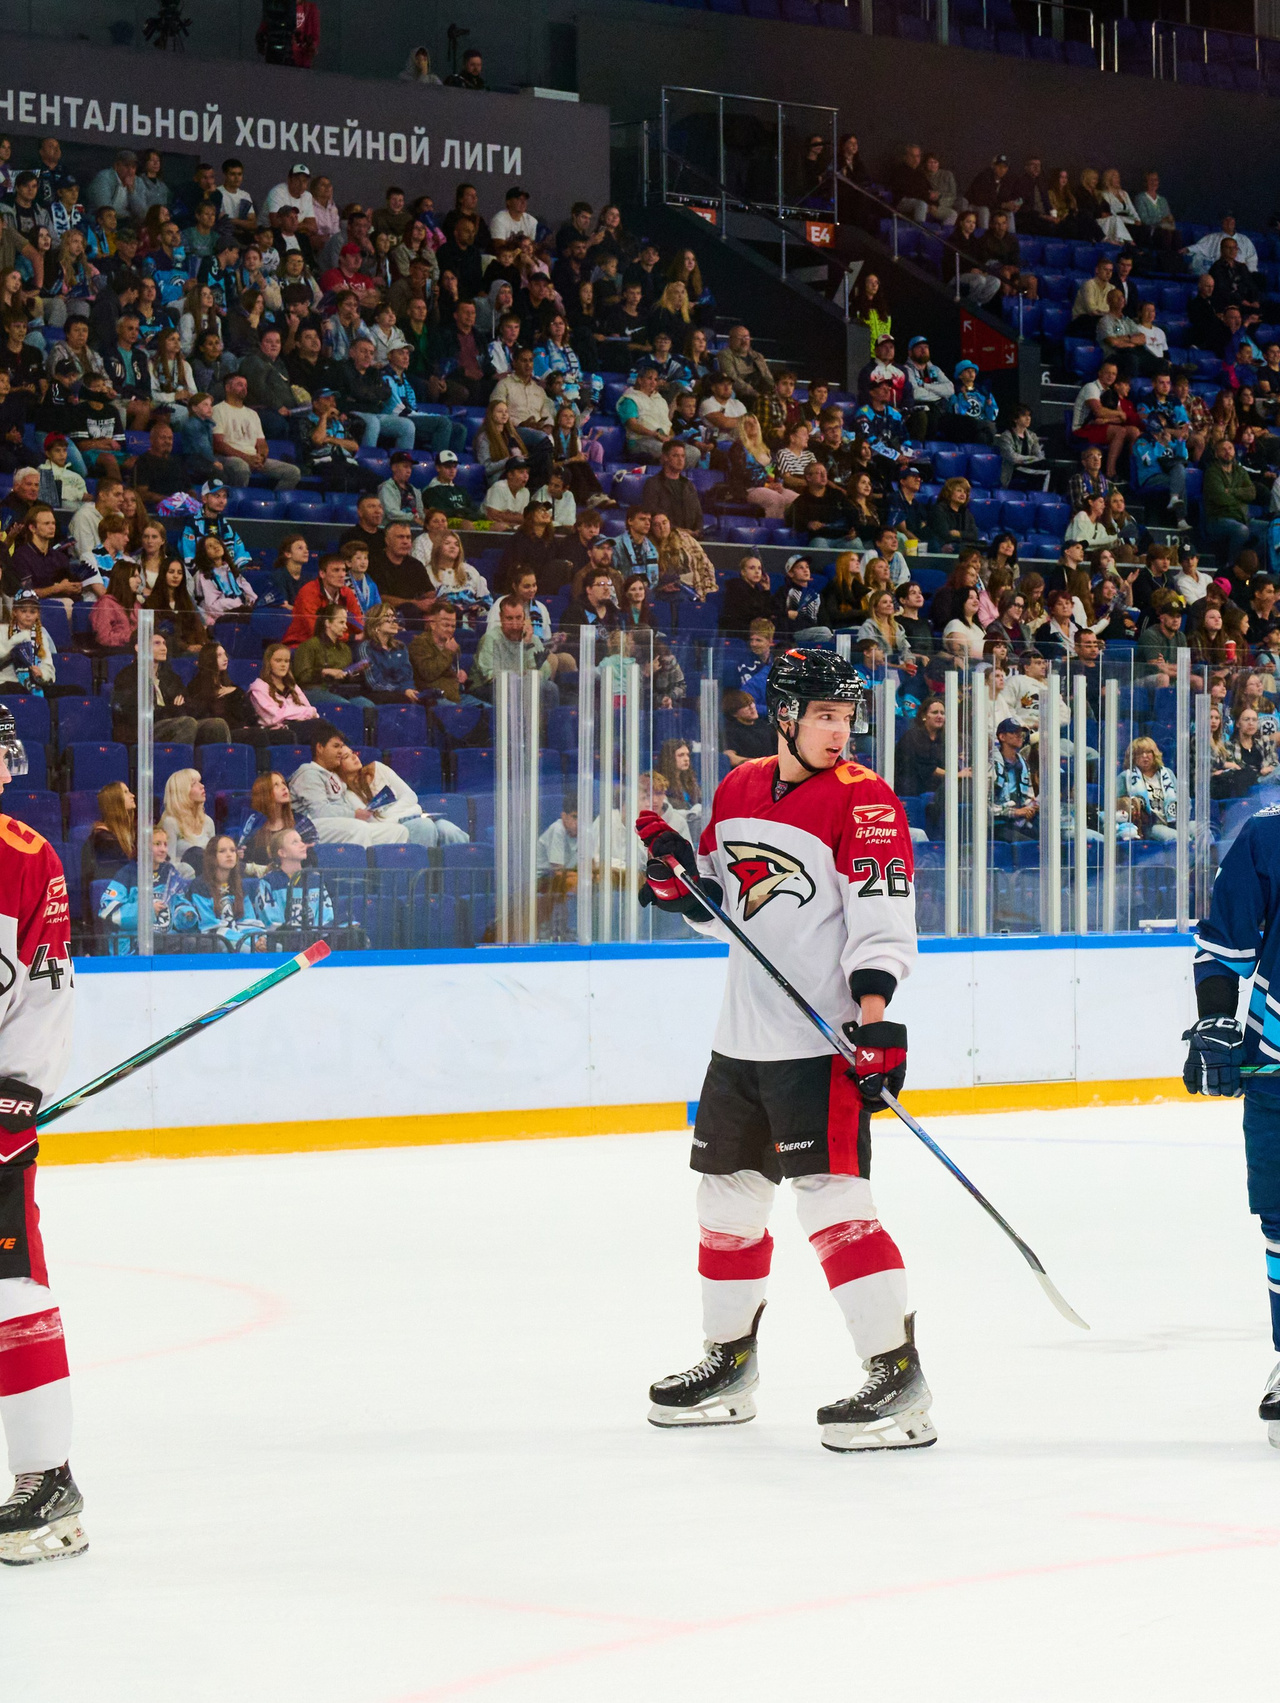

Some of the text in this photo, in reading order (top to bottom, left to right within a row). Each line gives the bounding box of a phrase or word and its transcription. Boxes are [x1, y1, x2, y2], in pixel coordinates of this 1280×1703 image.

[235, 116, 430, 167] ХОККЕЙНОЙ
[440, 139, 523, 176] ЛИГИ
[811, 226, 831, 243] E4
[853, 857, 912, 898] 26
[29, 943, 75, 991] 4
